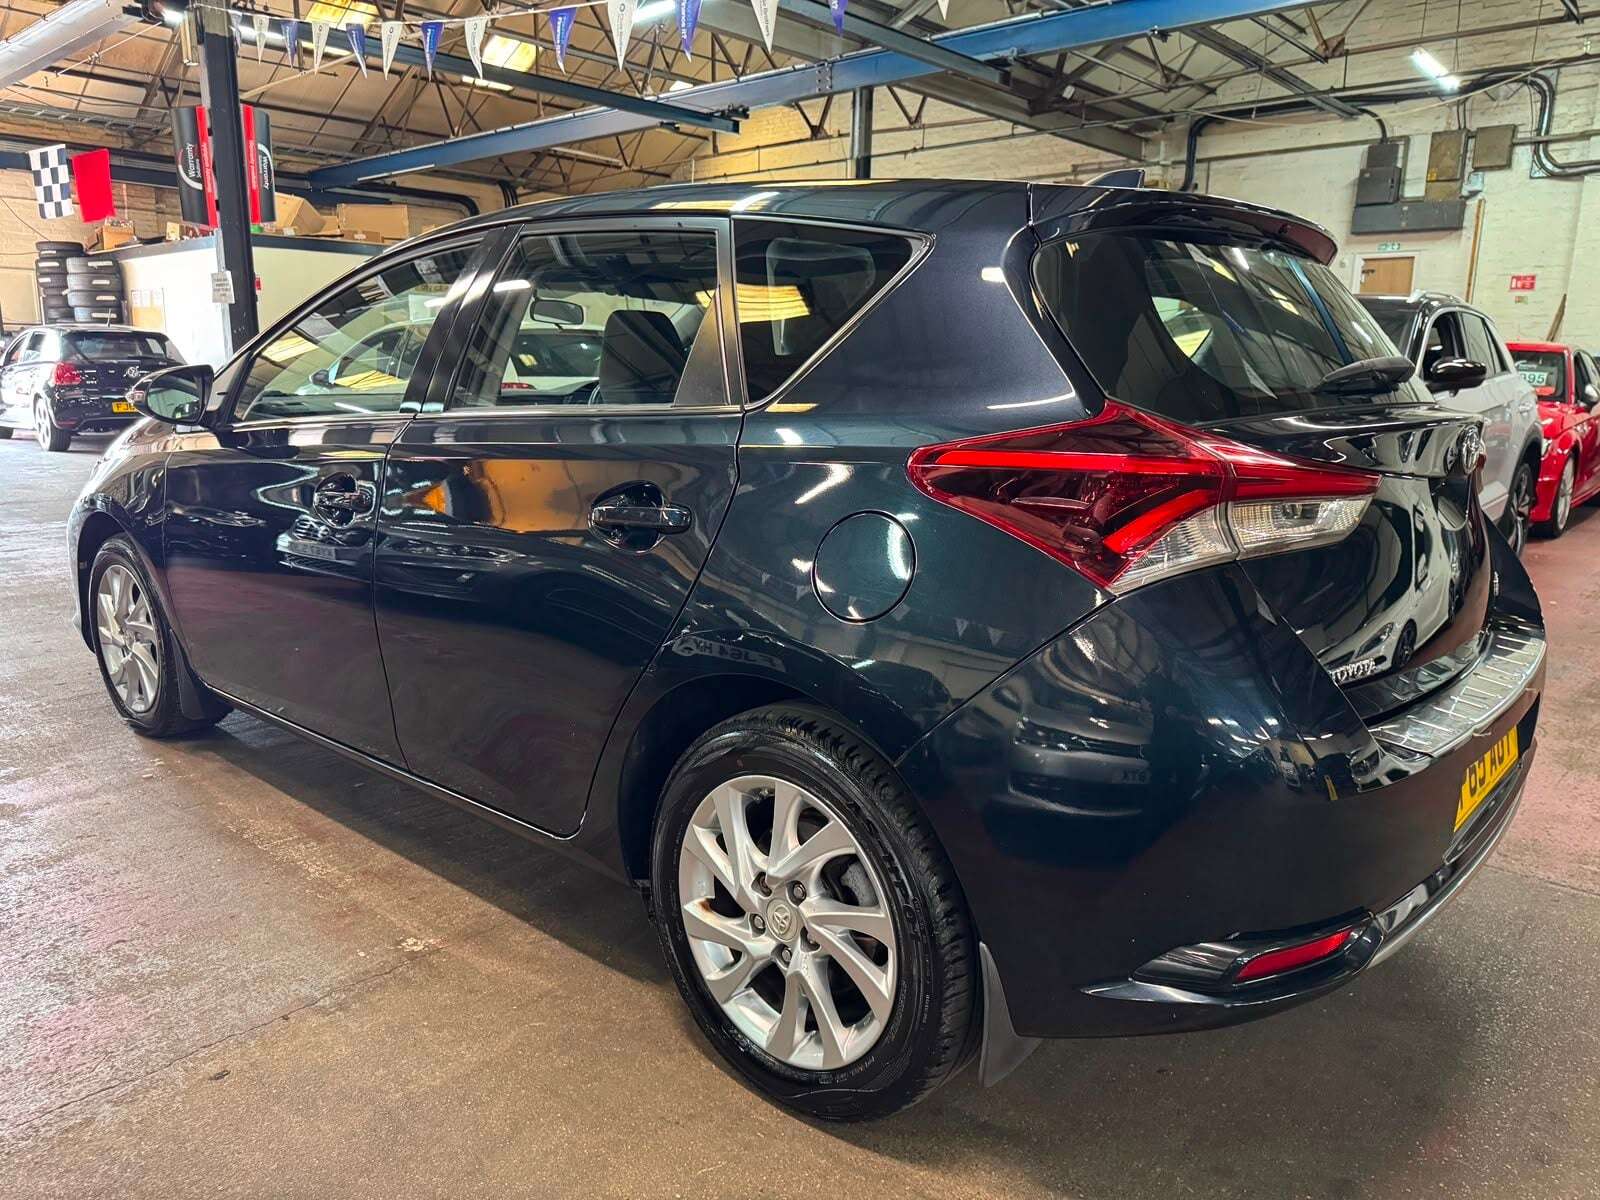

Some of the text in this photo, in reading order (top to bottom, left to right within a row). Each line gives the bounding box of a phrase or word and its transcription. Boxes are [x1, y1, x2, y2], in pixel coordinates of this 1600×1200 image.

[186, 142, 196, 178] Warranty
[262, 156, 270, 190] Warranty
[1331, 657, 1377, 682] TOYOTA
